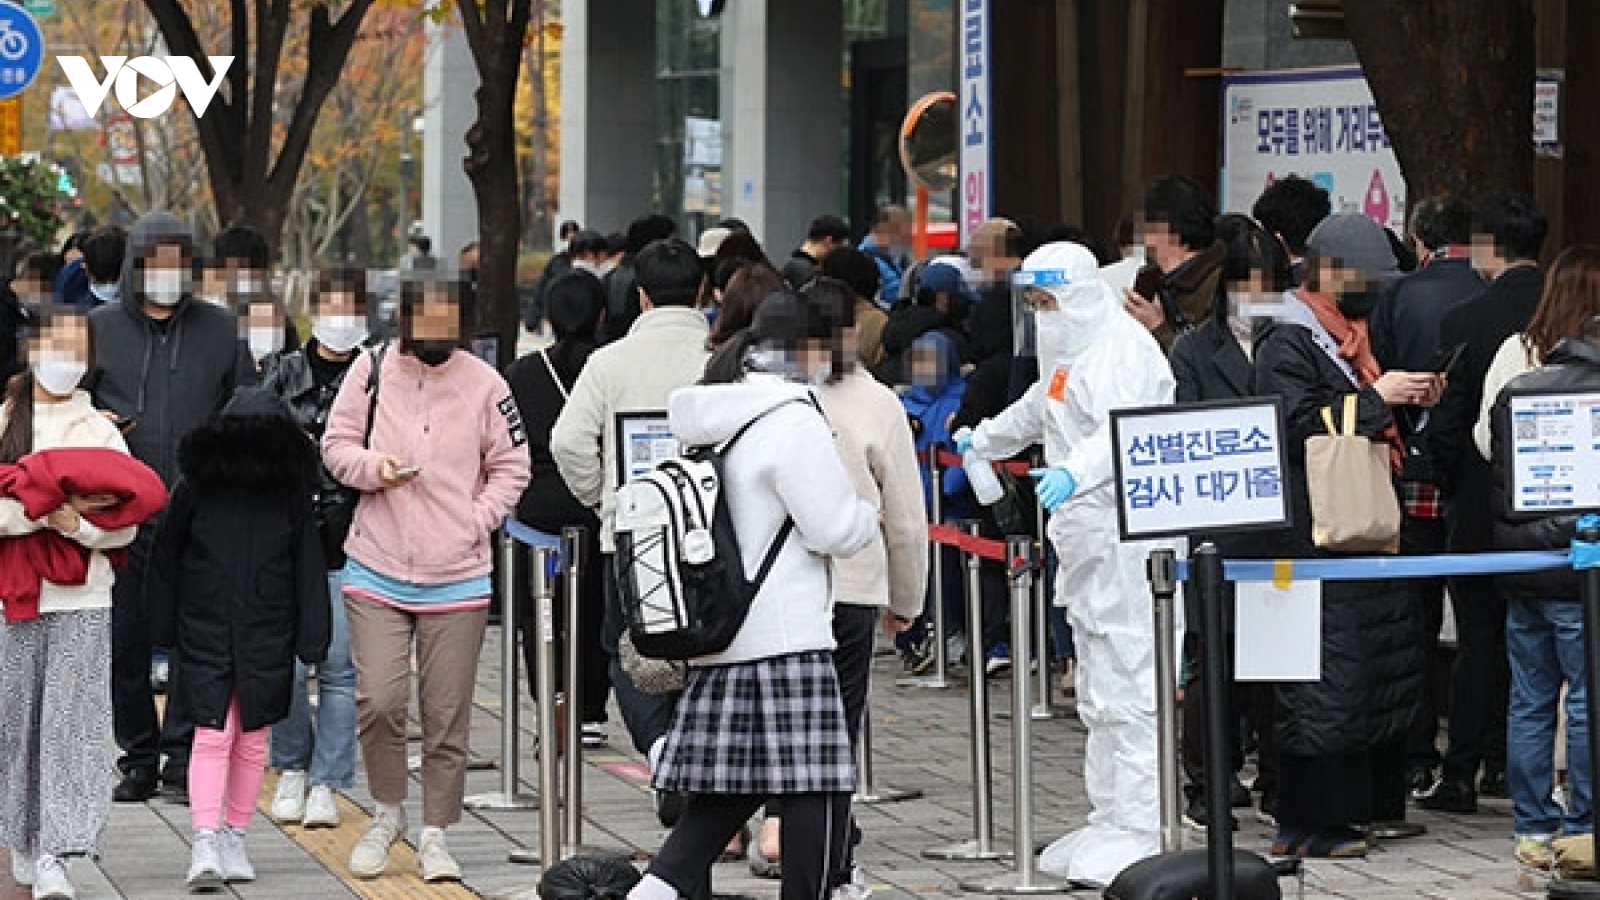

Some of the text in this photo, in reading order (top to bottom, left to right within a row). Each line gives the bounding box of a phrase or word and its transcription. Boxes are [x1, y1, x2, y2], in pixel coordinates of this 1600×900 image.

[965, 0, 982, 147] 료소
[1258, 108, 1299, 156] 모두를
[1303, 106, 1332, 154] 위해
[1336, 106, 1393, 153] 거리두
[1128, 425, 1273, 466] 선별진료소
[1127, 466, 1281, 508] 검사 대기줄
